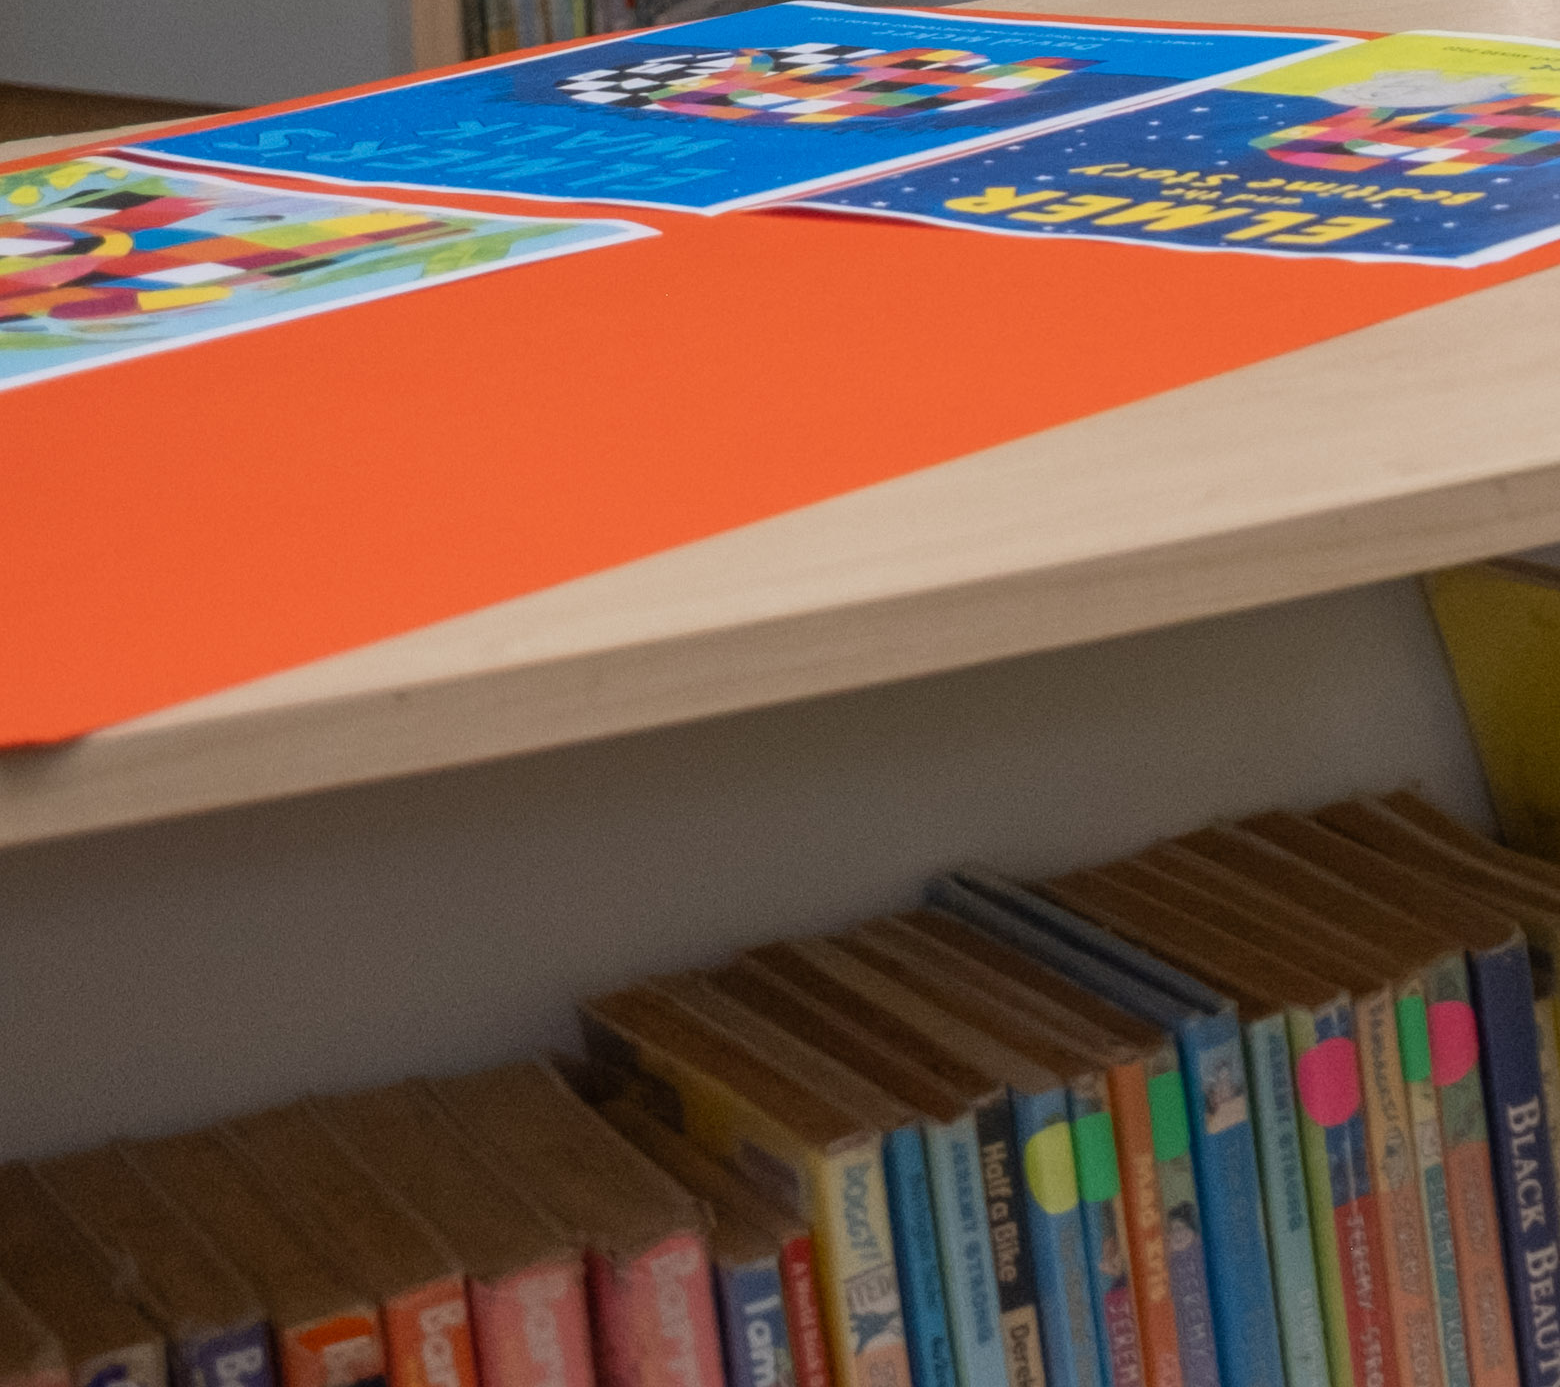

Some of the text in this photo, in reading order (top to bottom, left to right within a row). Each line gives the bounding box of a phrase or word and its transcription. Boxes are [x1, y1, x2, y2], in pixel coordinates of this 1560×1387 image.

[872, 30, 1102, 52] David McKee
[964, 186, 1394, 245] ELMER
[1068, 163, 1487, 206] Bedtime Story
[1160, 187, 1303, 205] and the
[1505, 1094, 1547, 1233] BLACK
[982, 1140, 1021, 1283] Half a Bike
[964, 1243, 995, 1343] STRONG
[1343, 1215, 1376, 1309] JEREMY
[746, 1317, 778, 1386] am
